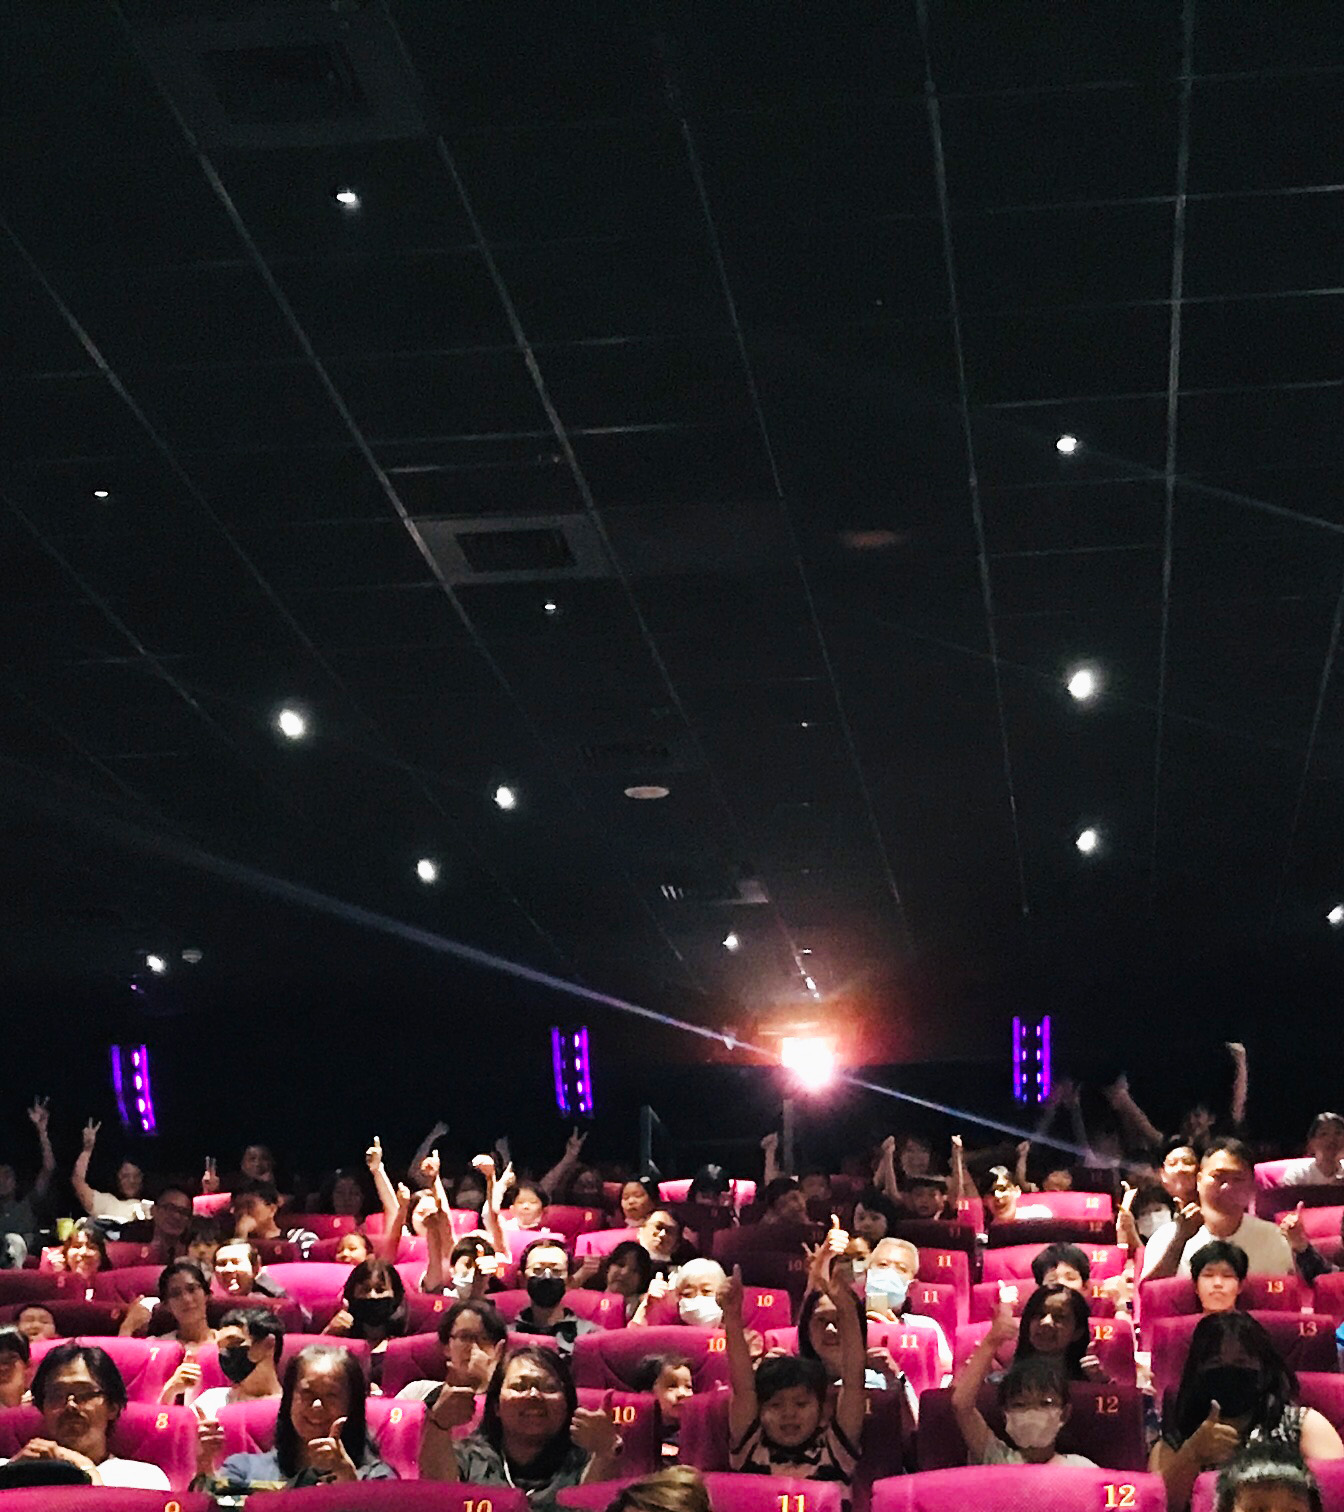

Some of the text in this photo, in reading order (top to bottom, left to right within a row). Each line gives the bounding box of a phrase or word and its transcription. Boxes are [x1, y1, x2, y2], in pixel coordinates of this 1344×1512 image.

[957, 1199, 970, 1211] 11
[459, 1213, 466, 1224] 7
[937, 1254, 953, 1267] 11
[1091, 1249, 1108, 1263] 12
[1266, 1280, 1284, 1293] 13
[756, 1294, 773, 1307] 10
[922, 1290, 940, 1303] 11
[433, 1300, 443, 1312] 8
[1094, 1325, 1114, 1341] 12
[1298, 1320, 1318, 1336] 13
[707, 1336, 727, 1352] 10
[900, 1334, 920, 1350] 11
[150, 1348, 159, 1361] 7
[1094, 1395, 1120, 1414] 12
[156, 1413, 168, 1430] 8
[390, 1407, 402, 1424] 9
[611, 1405, 636, 1424] 10
[1103, 1485, 1137, 1508] 12
